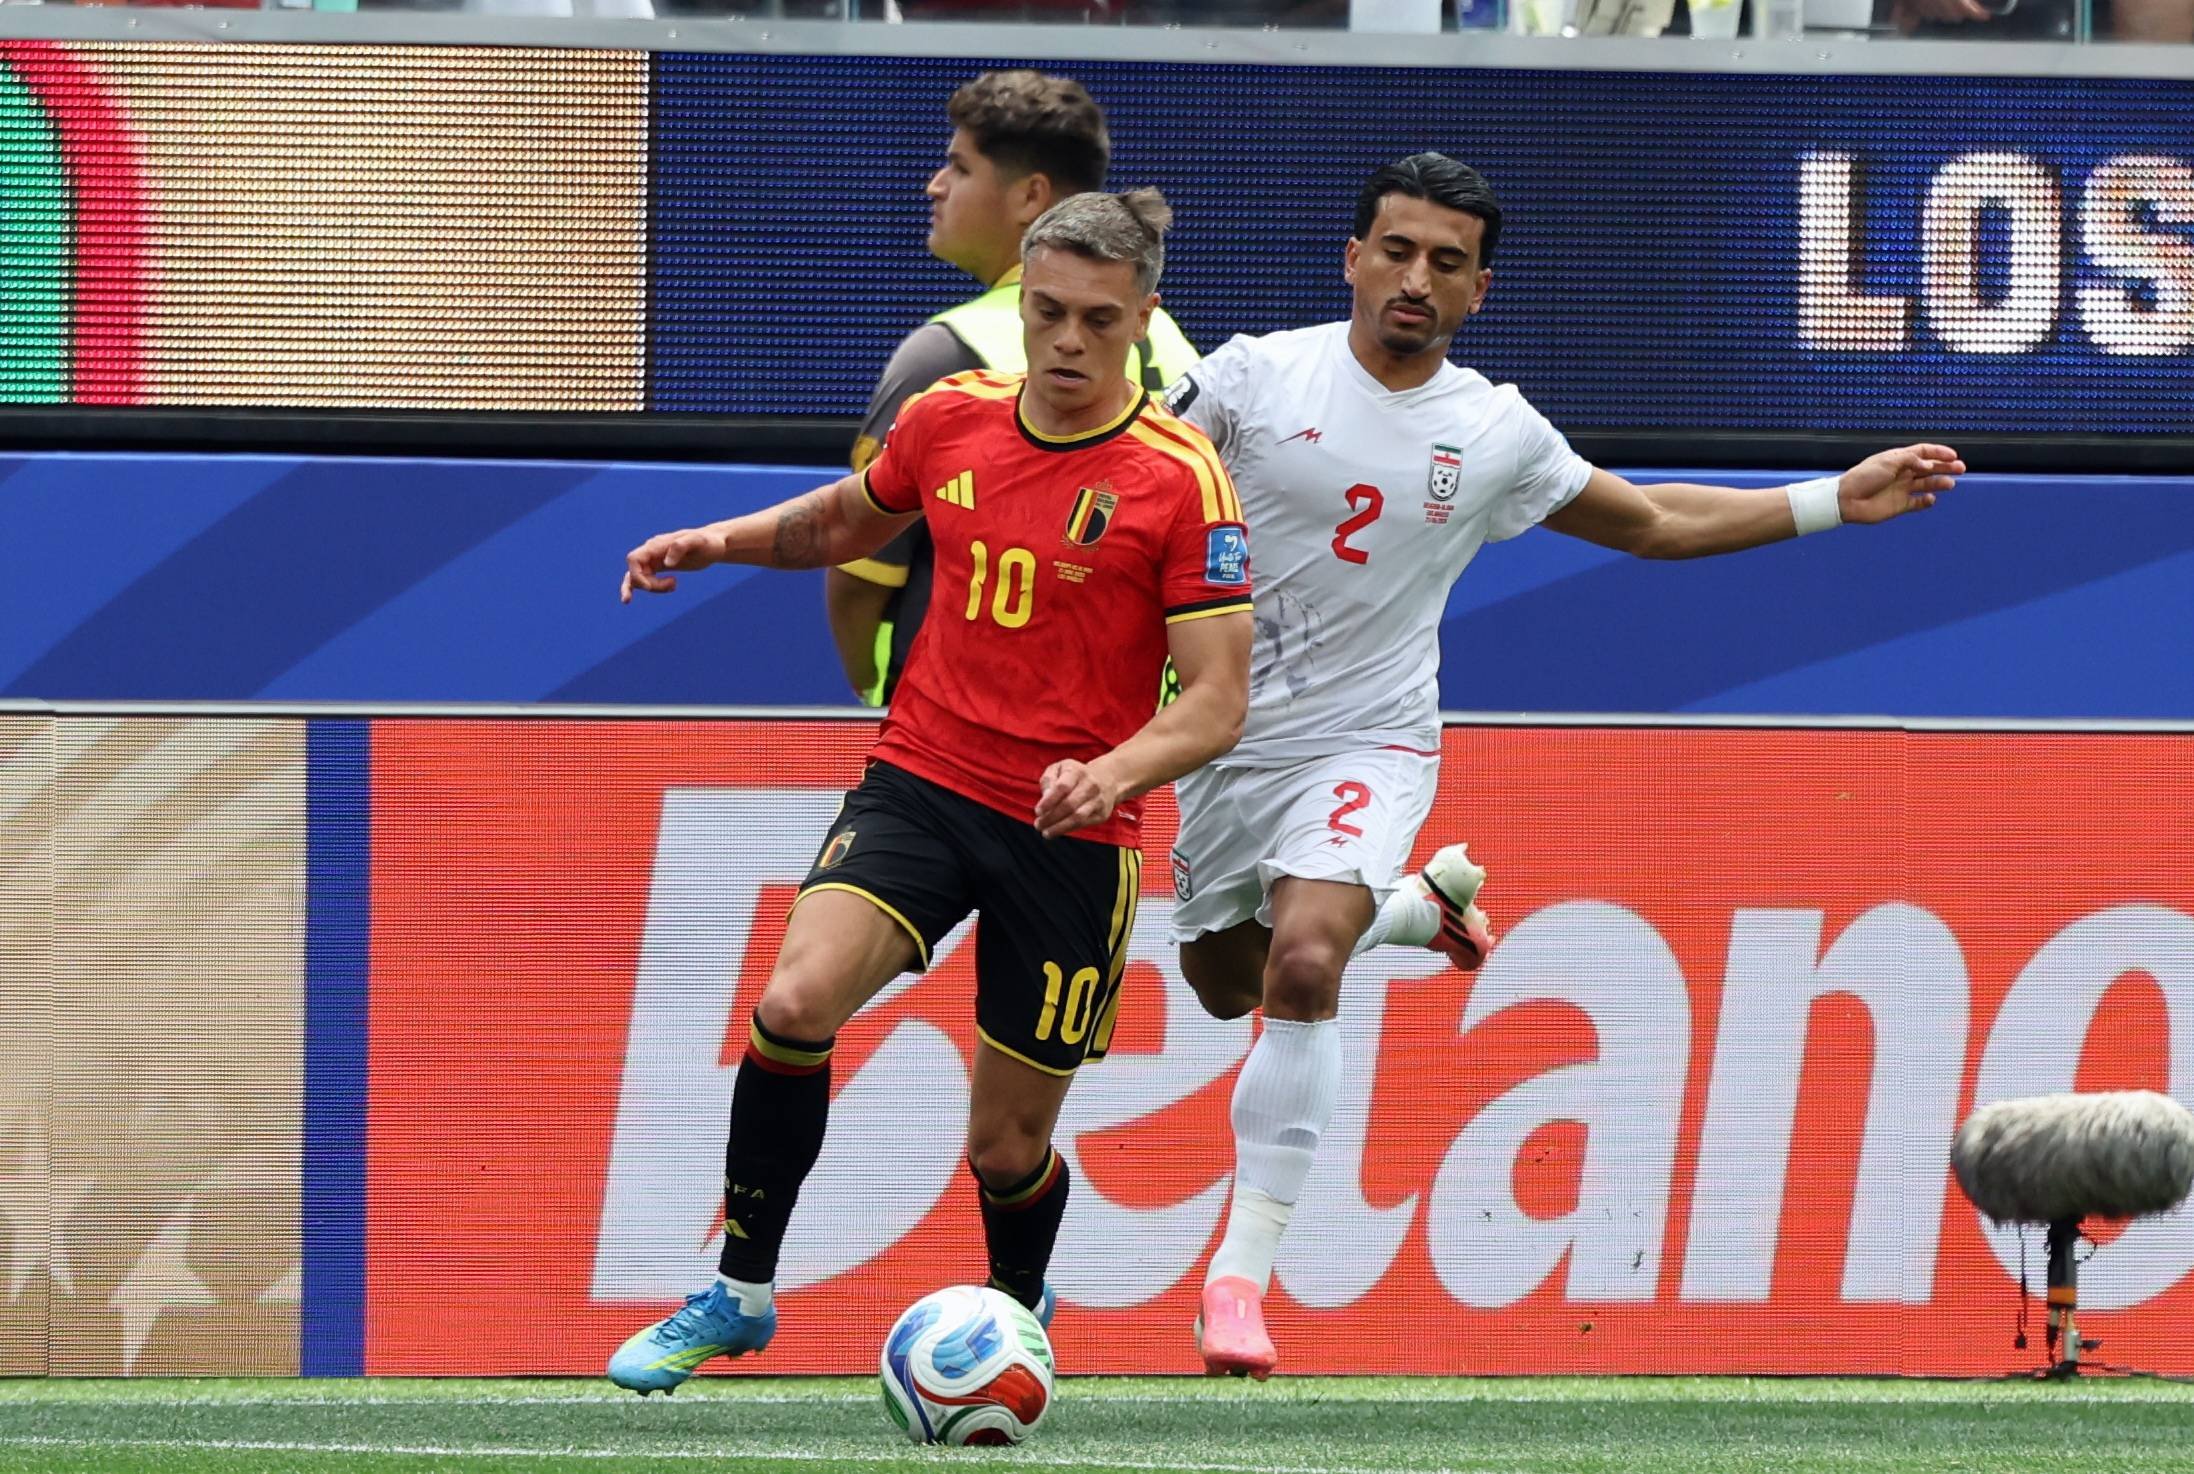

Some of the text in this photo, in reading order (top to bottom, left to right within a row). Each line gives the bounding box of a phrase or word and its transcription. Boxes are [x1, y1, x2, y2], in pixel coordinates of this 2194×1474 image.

[1797, 150, 2194, 356] LOS
[1331, 483, 1385, 565] 2
[965, 540, 1036, 629] 10
[1327, 781, 1371, 838] 2
[1035, 961, 1100, 1045] 10
